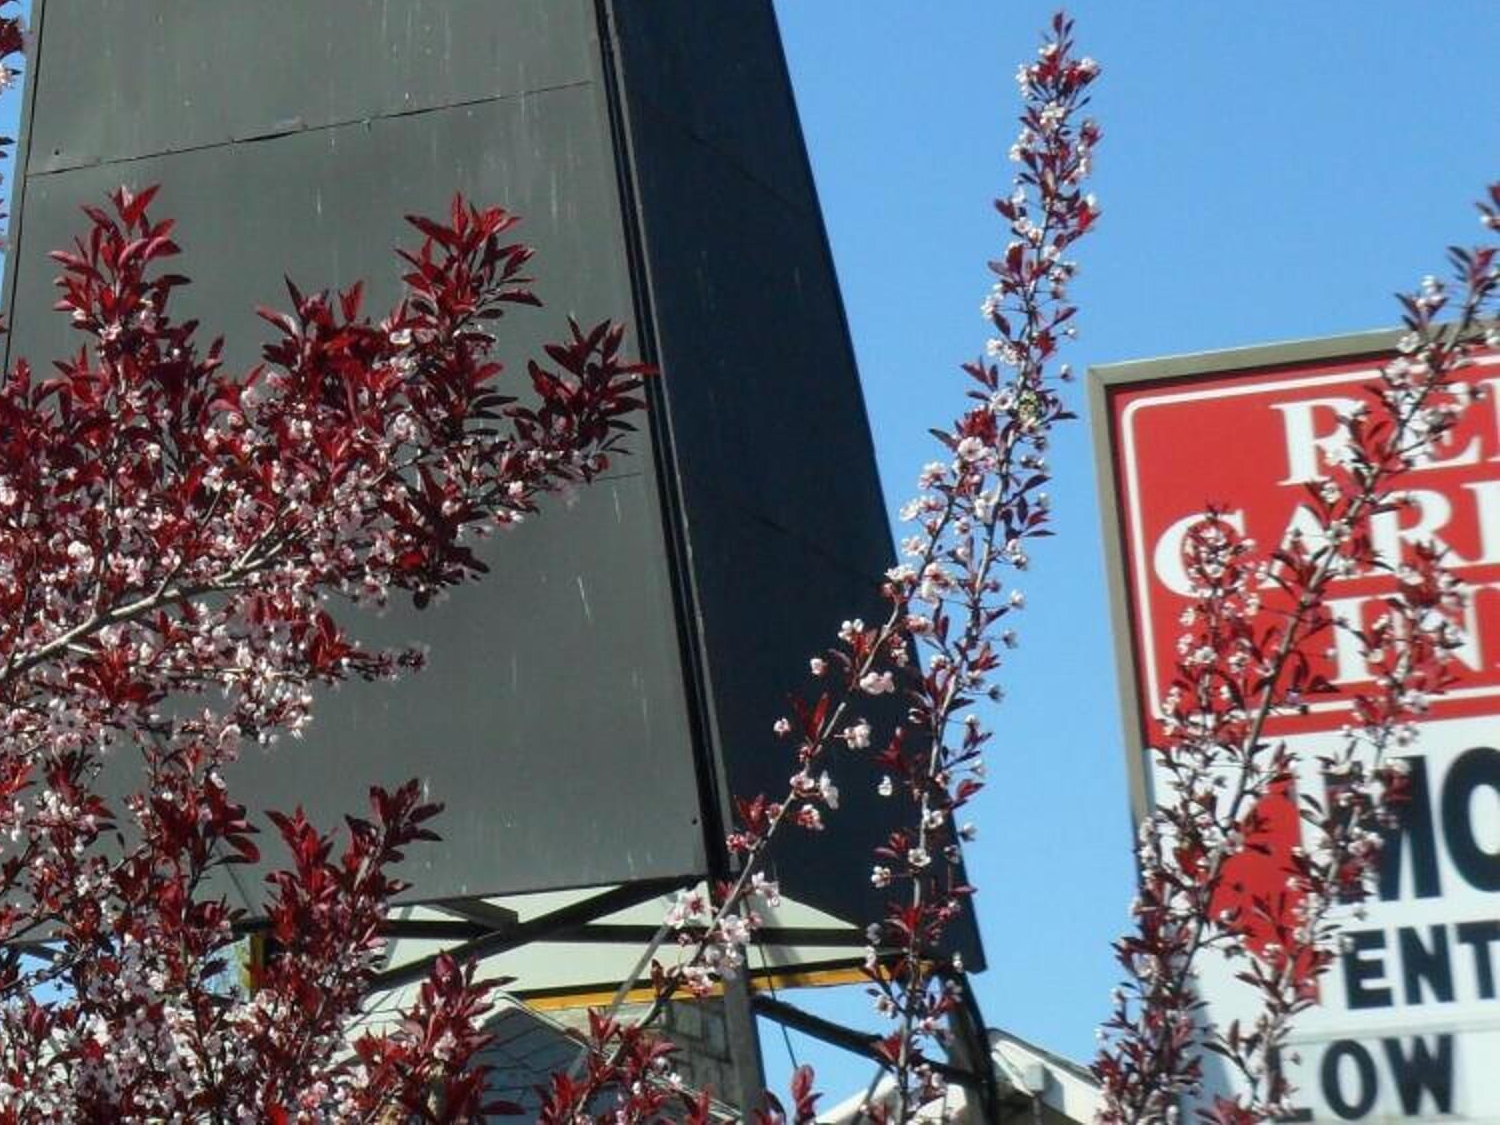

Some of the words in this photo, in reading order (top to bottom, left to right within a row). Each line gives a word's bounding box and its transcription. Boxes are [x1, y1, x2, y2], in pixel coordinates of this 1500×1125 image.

[1268, 377, 1500, 486] RE
[1322, 583, 1500, 685] IN
[1265, 1033, 1456, 1124] LOW
